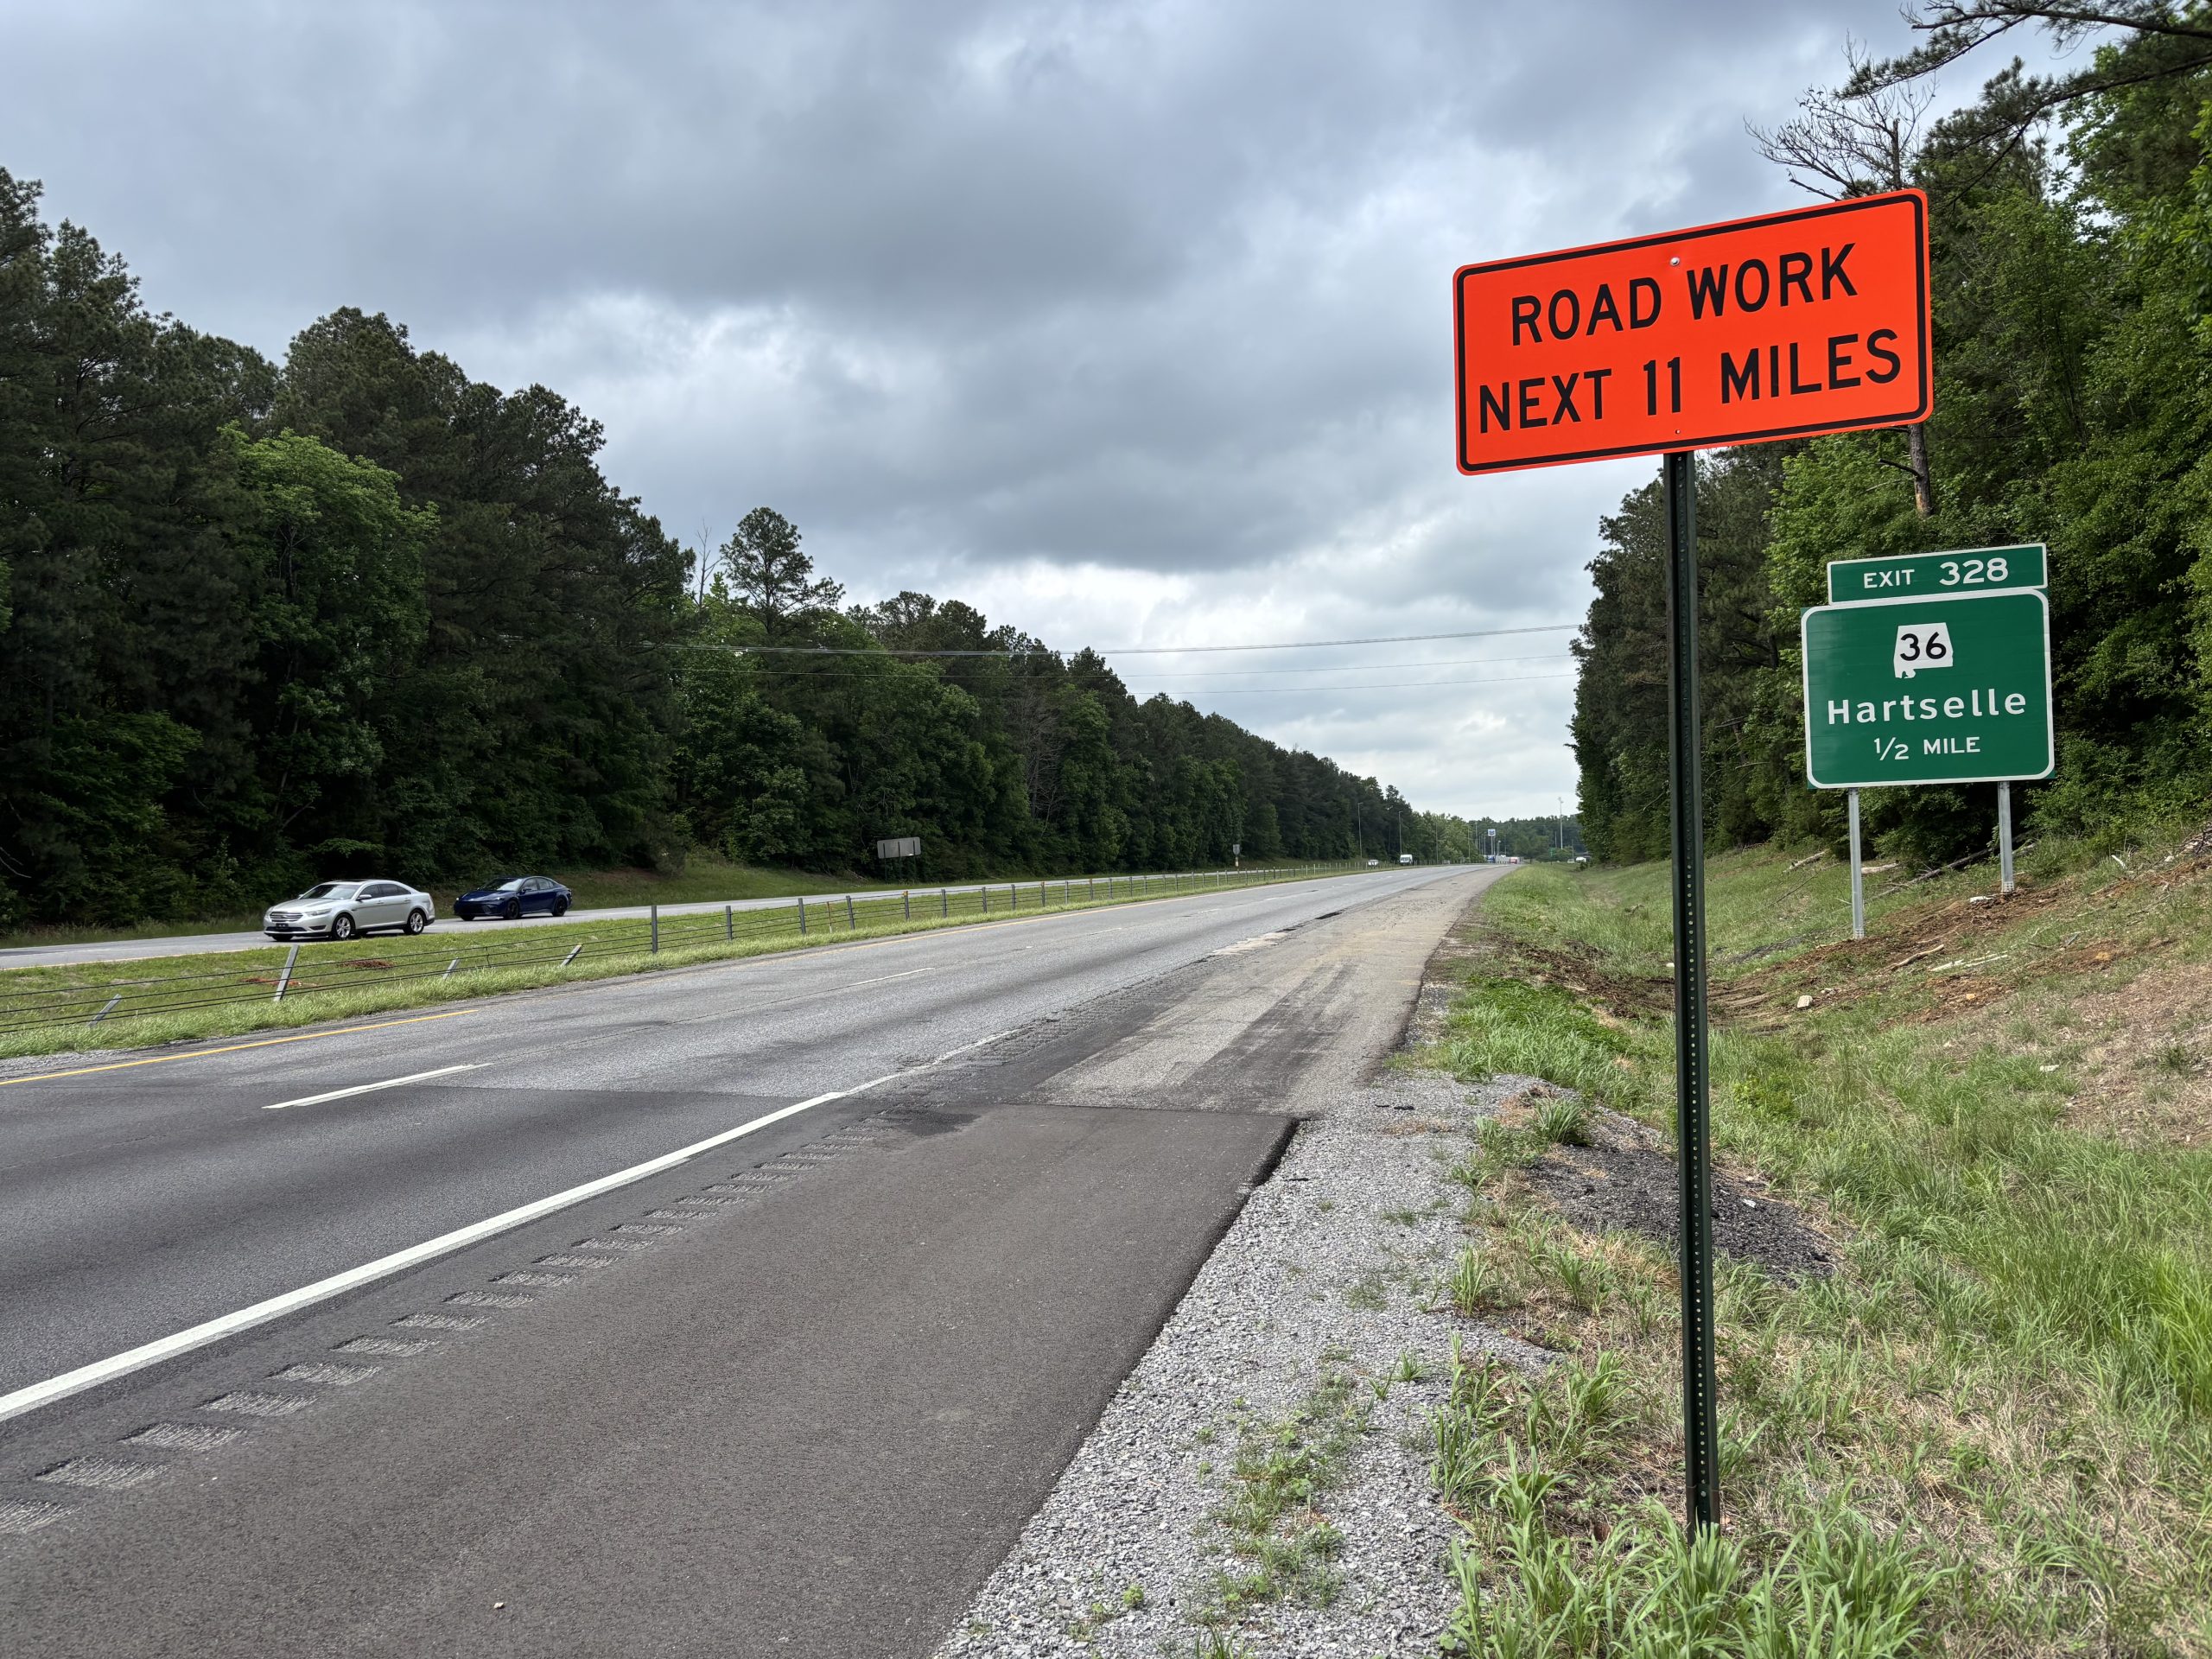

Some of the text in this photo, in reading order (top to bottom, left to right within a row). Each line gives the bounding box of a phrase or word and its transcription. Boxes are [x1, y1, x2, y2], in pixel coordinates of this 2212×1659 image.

[1512, 243, 1858, 346] ROAD WORK
[1480, 329, 1900, 433] NEXT 11 MILES
[1863, 558, 2008, 588] EXIT 328
[1900, 632, 1946, 661] 36
[1828, 689, 2025, 724] Hartselle
[1874, 737, 1980, 760] 1/2 MILE
